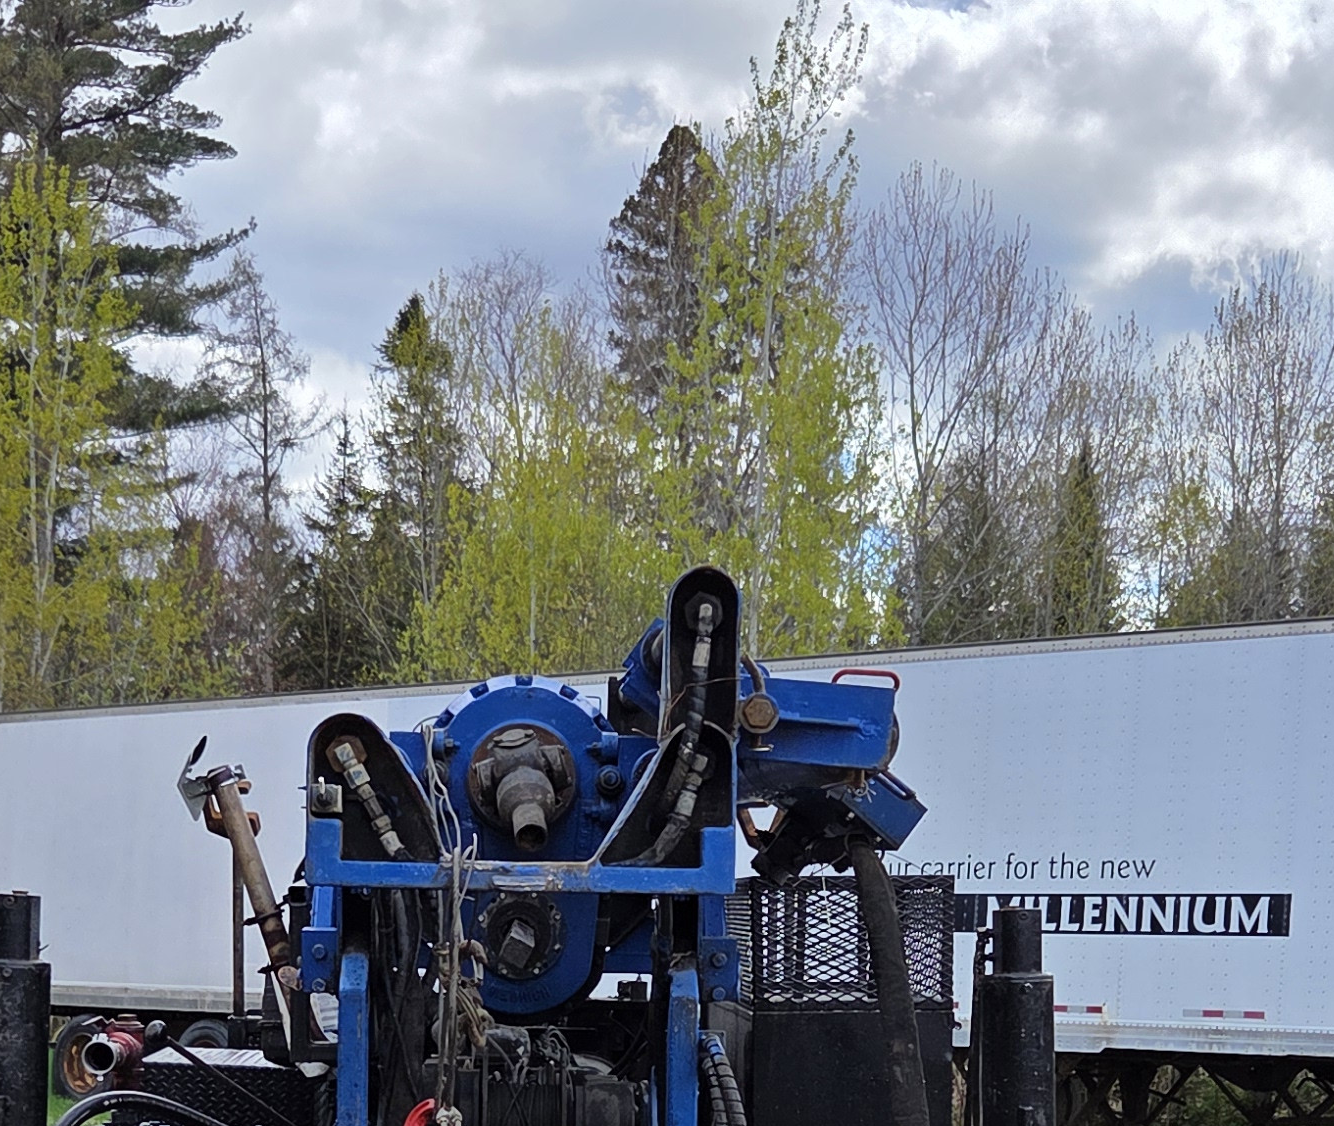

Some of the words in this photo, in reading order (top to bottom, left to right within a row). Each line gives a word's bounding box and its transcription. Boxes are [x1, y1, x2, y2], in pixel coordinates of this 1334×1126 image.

[920, 853, 997, 880] carrier
[1005, 852, 1040, 880] for
[1048, 851, 1090, 879] the
[1099, 858, 1156, 879] new
[986, 895, 1271, 934] MLLENNIUM
